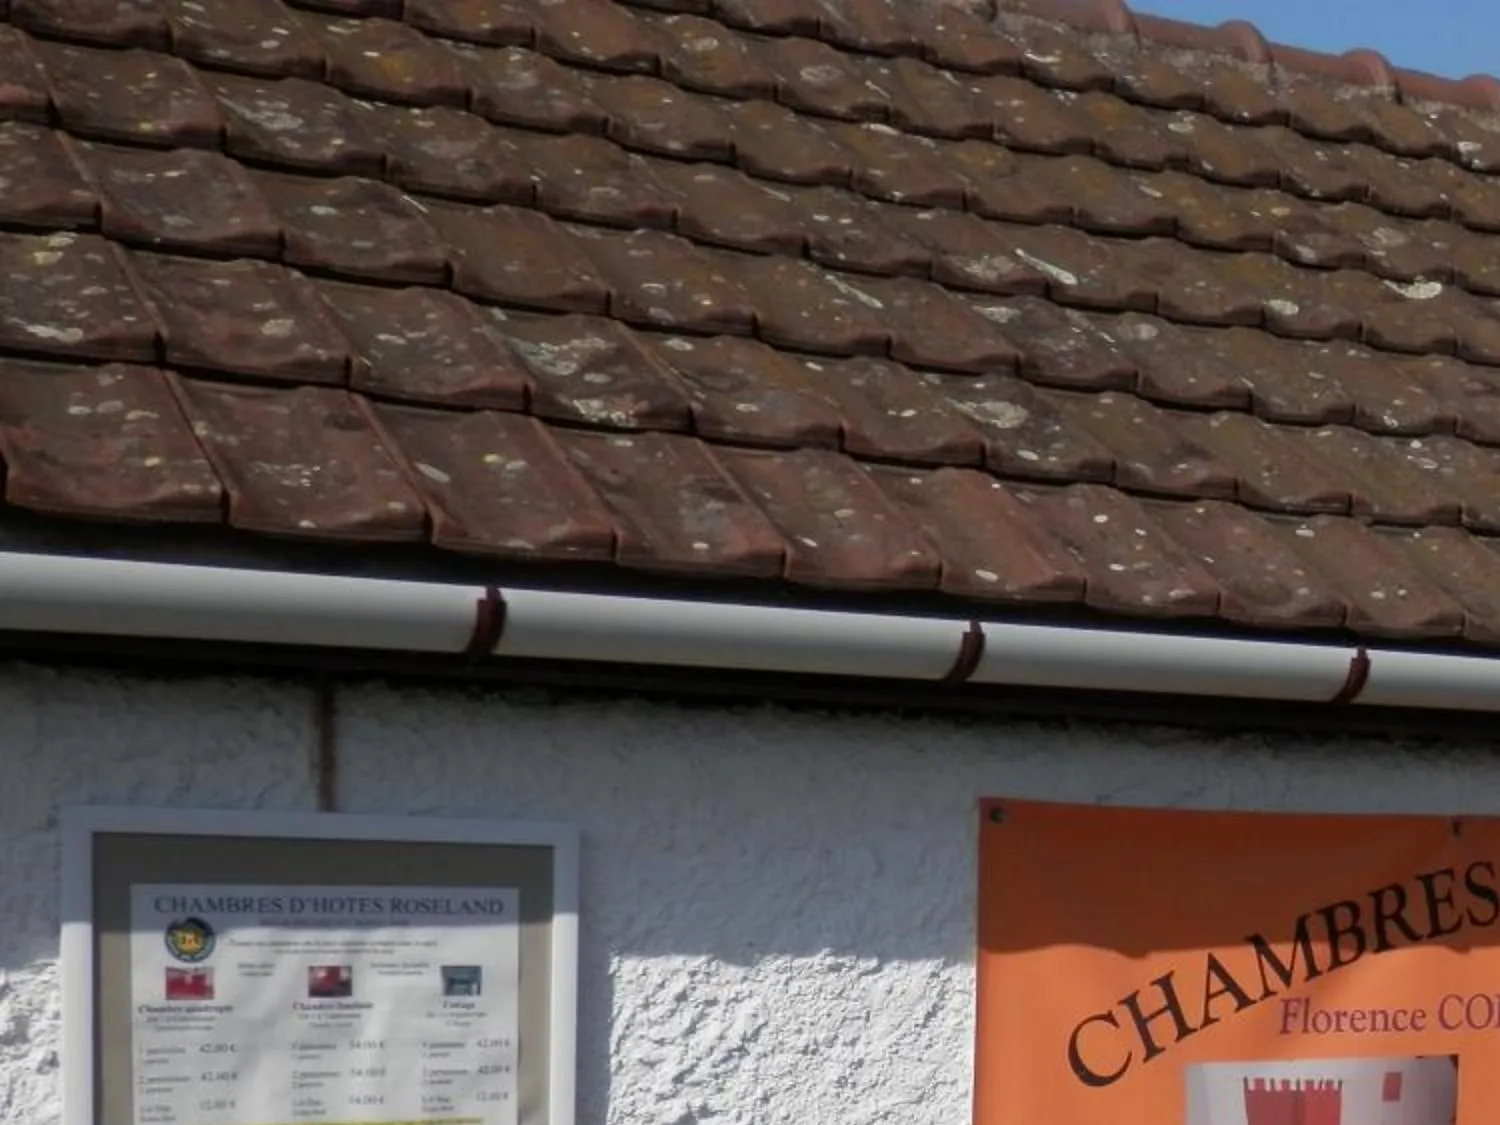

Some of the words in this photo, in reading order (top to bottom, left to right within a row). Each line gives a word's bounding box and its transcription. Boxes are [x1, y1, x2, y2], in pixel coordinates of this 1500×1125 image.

[154, 896, 283, 914] CHAMBRES
[289, 896, 384, 914] D'HOTES
[390, 897, 504, 915] ROSELAND
[1067, 861, 1500, 1088] CHAMBRES
[1279, 996, 1426, 1034] Florence
